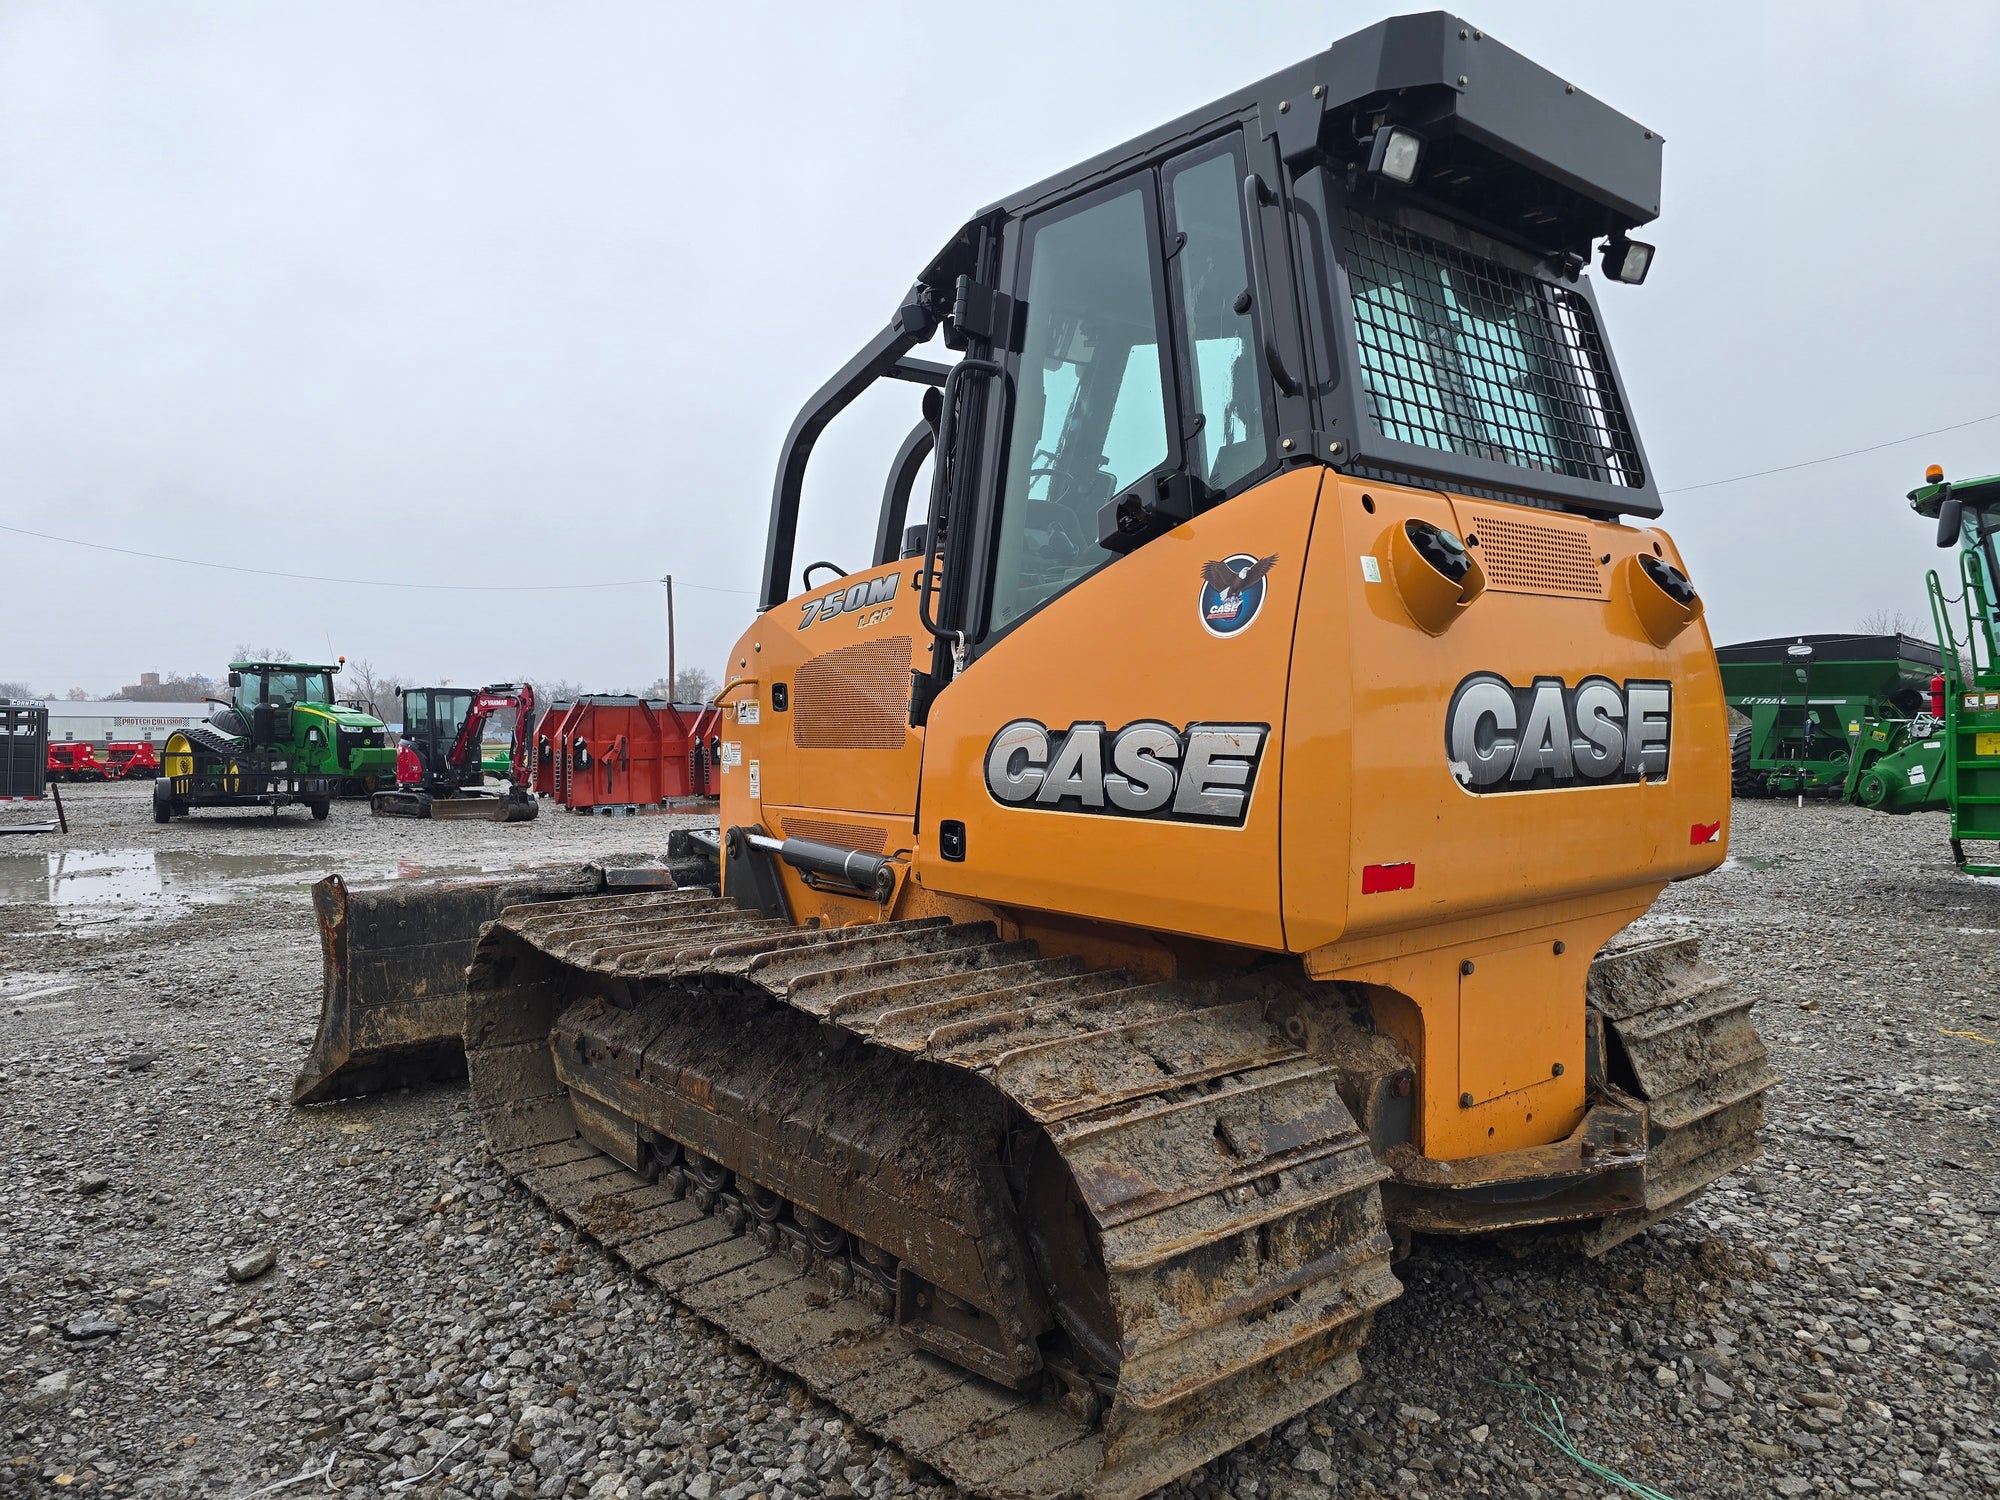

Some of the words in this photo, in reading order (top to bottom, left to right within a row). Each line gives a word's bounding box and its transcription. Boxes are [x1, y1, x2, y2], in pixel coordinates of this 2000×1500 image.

[798, 572, 900, 630] 750M
[1209, 600, 1242, 614] CASE
[1446, 672, 1671, 786] CASE
[986, 719, 1268, 820] CASE
